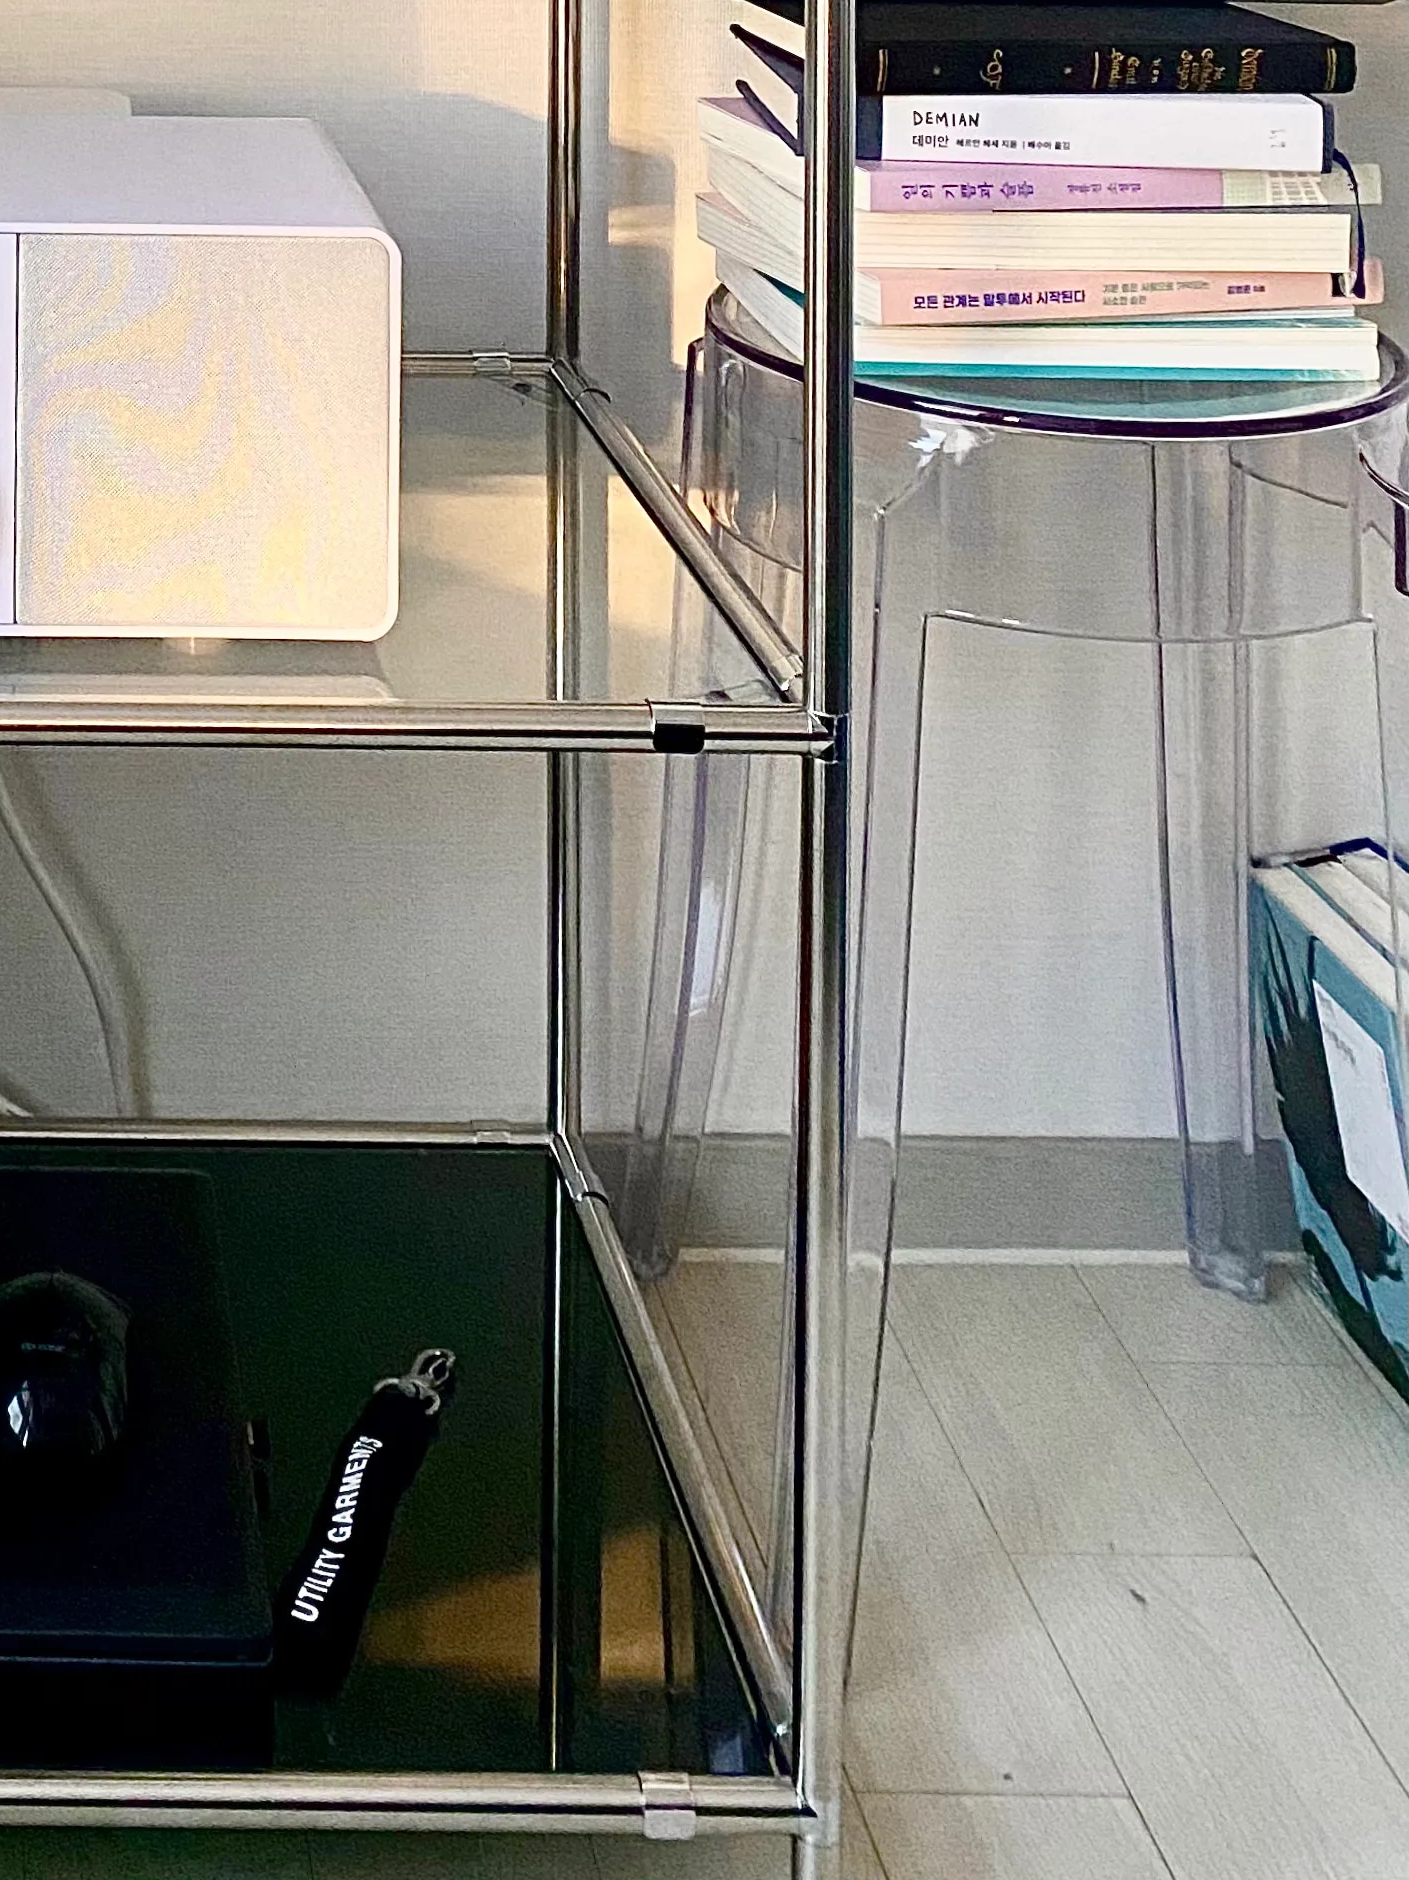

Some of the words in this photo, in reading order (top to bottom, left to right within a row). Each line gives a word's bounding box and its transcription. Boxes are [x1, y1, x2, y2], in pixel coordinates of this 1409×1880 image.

[913, 111, 979, 128] DEMIAN
[912, 134, 949, 148] 데미안
[901, 184, 936, 200] 일의
[913, 294, 939, 309] 모든
[942, 294, 981, 309] 관계는
[983, 291, 1033, 307] 말투에서
[1036, 289, 1087, 305] 시작된다
[291, 1548, 346, 1622] UTILITY
[327, 1436, 384, 1544] GARMENTS
